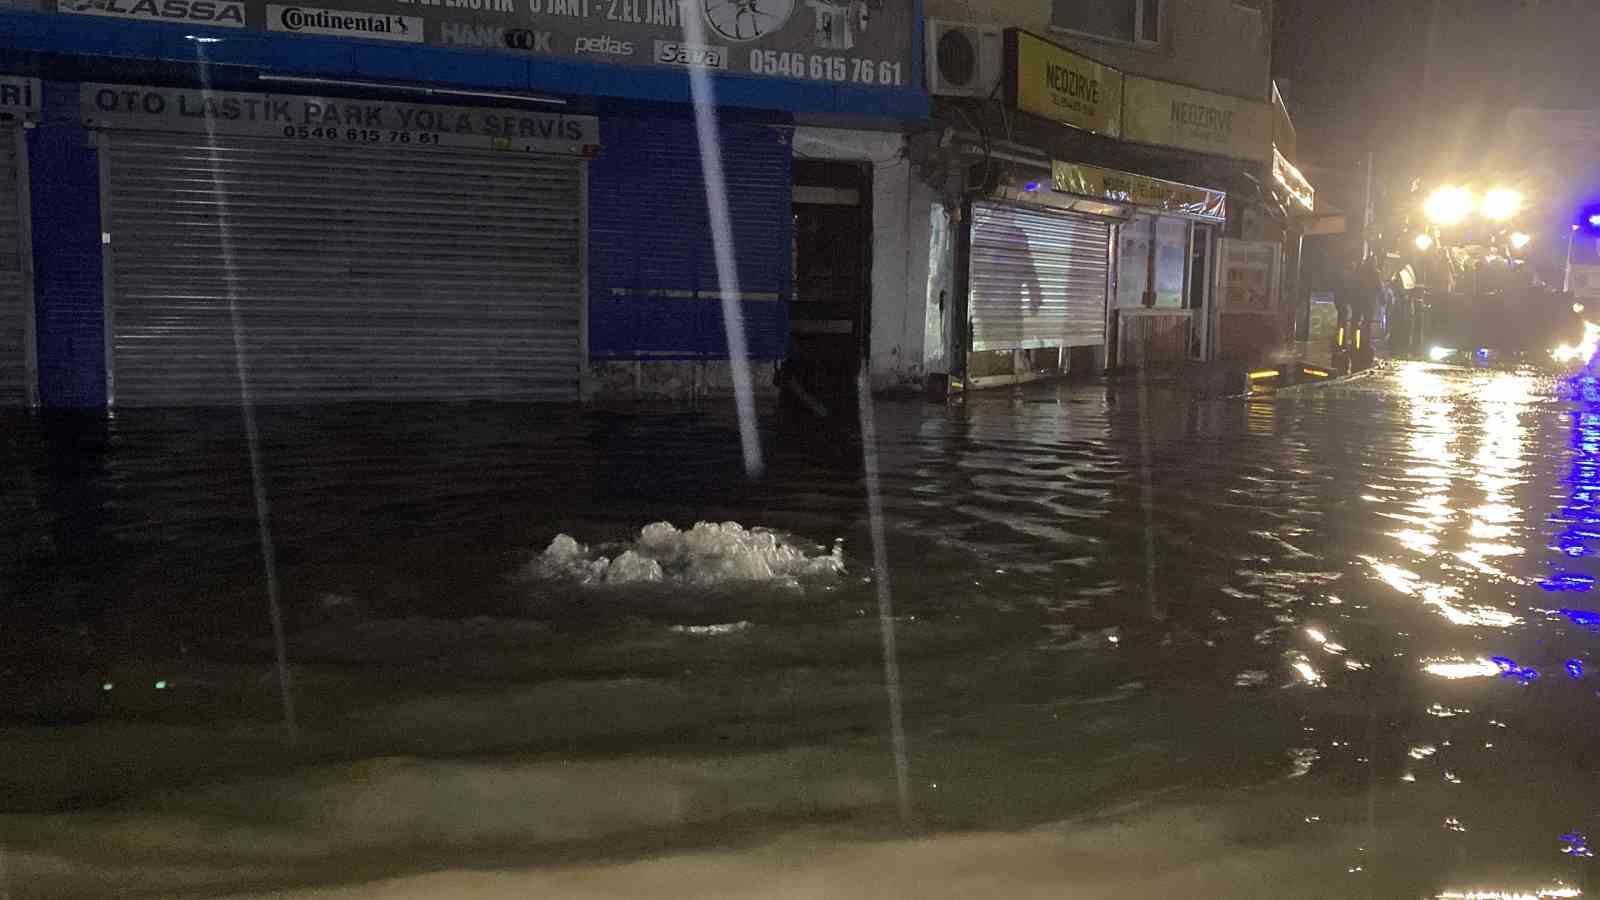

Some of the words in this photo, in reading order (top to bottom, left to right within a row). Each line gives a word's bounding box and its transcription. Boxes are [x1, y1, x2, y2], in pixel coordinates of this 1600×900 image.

[280, 7, 390, 34] Continental
[750, 49, 804, 79] 0546
[809, 53, 847, 81] 615
[851, 59, 874, 84] 76
[878, 62, 902, 86] 61
[96, 88, 166, 114] OTO
[177, 93, 293, 122] LASTİK
[302, 102, 383, 126] PARK
[397, 109, 474, 133] YOLA
[484, 112, 584, 142] SERVİS
[283, 125, 335, 139] 0546
[346, 129, 380, 142] 615
[390, 131, 411, 144] 76
[418, 132, 440, 145] 61
